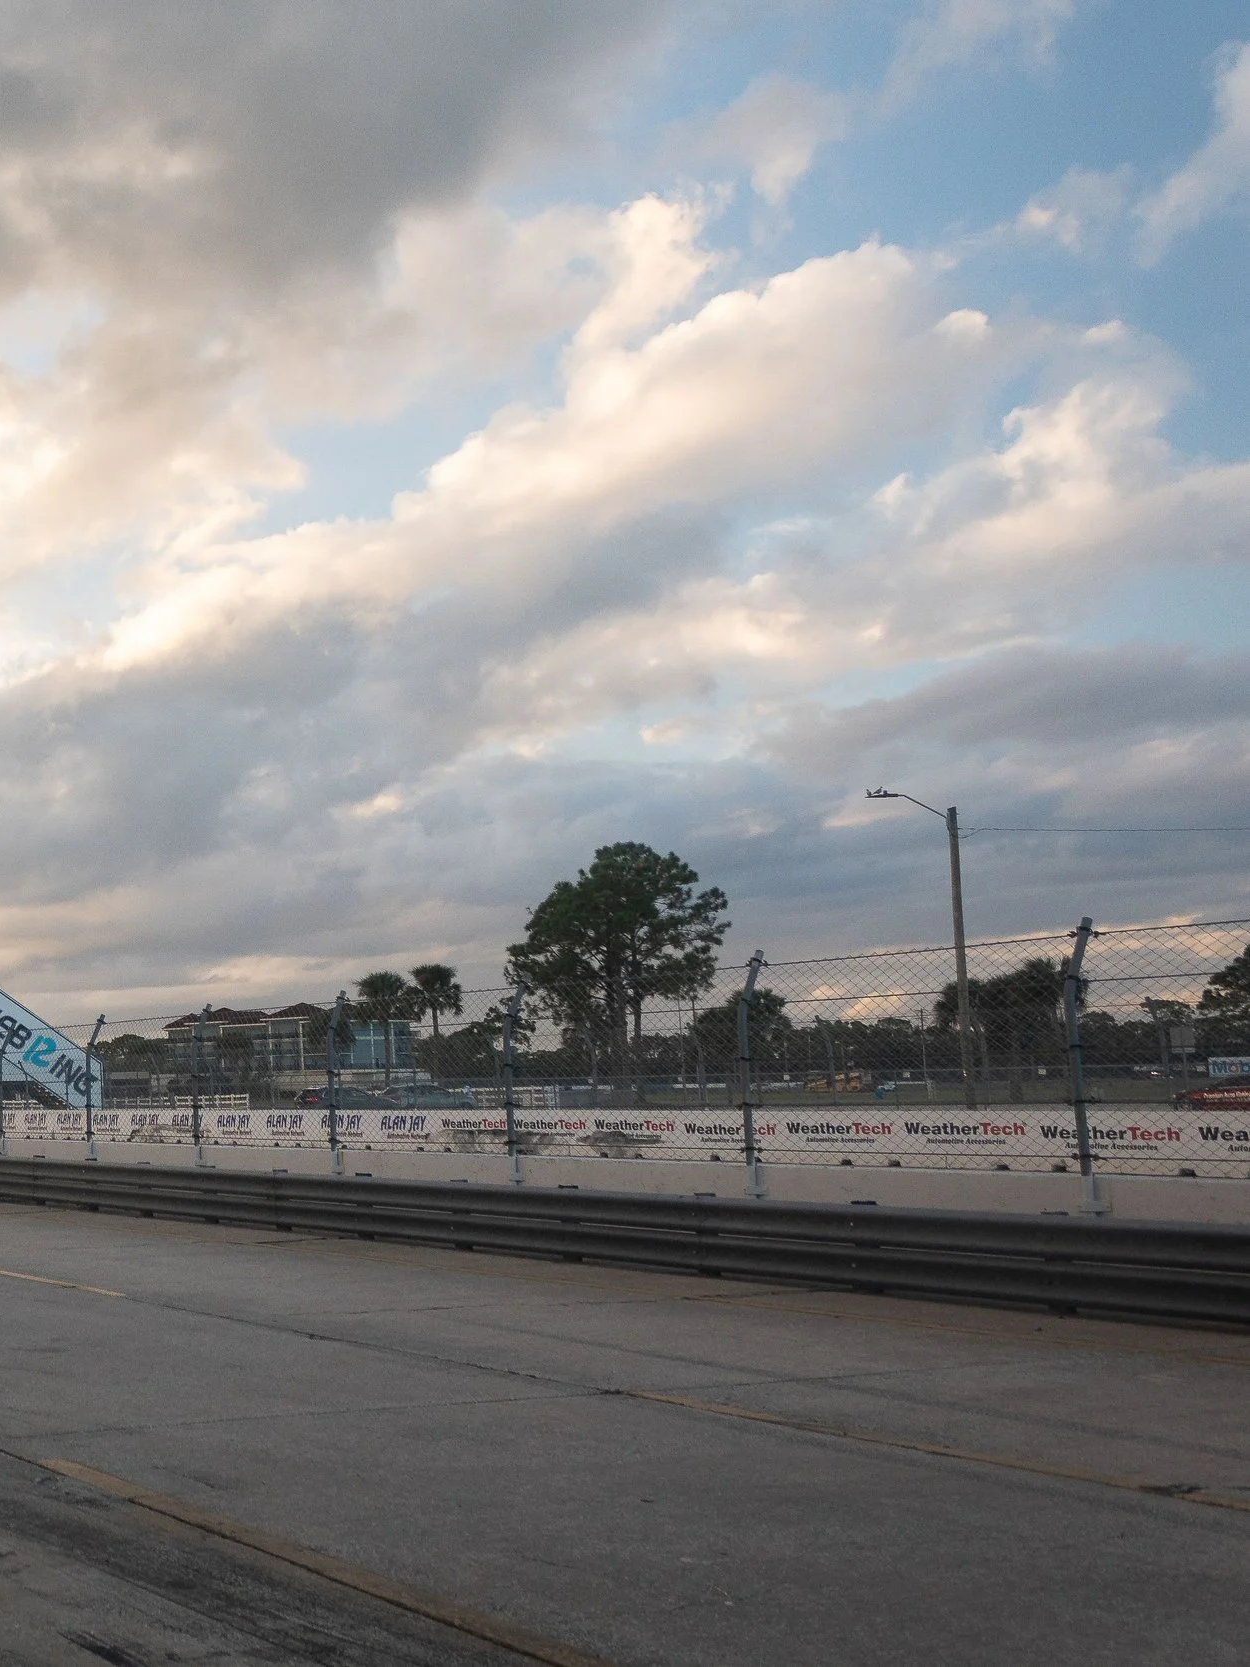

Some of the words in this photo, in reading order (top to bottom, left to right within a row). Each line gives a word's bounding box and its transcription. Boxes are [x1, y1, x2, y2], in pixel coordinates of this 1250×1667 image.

[217, 1115, 237, 1128] ALAN
[266, 1115, 288, 1128] ALAN
[288, 1115, 303, 1130] JAY
[321, 1115, 344, 1128] ALN
[345, 1115, 362, 1131] JAY
[380, 1115, 407, 1131] ALAN
[407, 1115, 426, 1132] JAY
[441, 1119, 507, 1129] WeatherTech
[513, 1119, 586, 1130] WeatherTech
[594, 1119, 675, 1132] WeatherTech
[785, 1122, 892, 1135] WeatherTech
[904, 1122, 1026, 1136] WeatherTech
[1040, 1125, 1181, 1142] WeaherTech
[1110, 1143, 1159, 1151] Accessories
